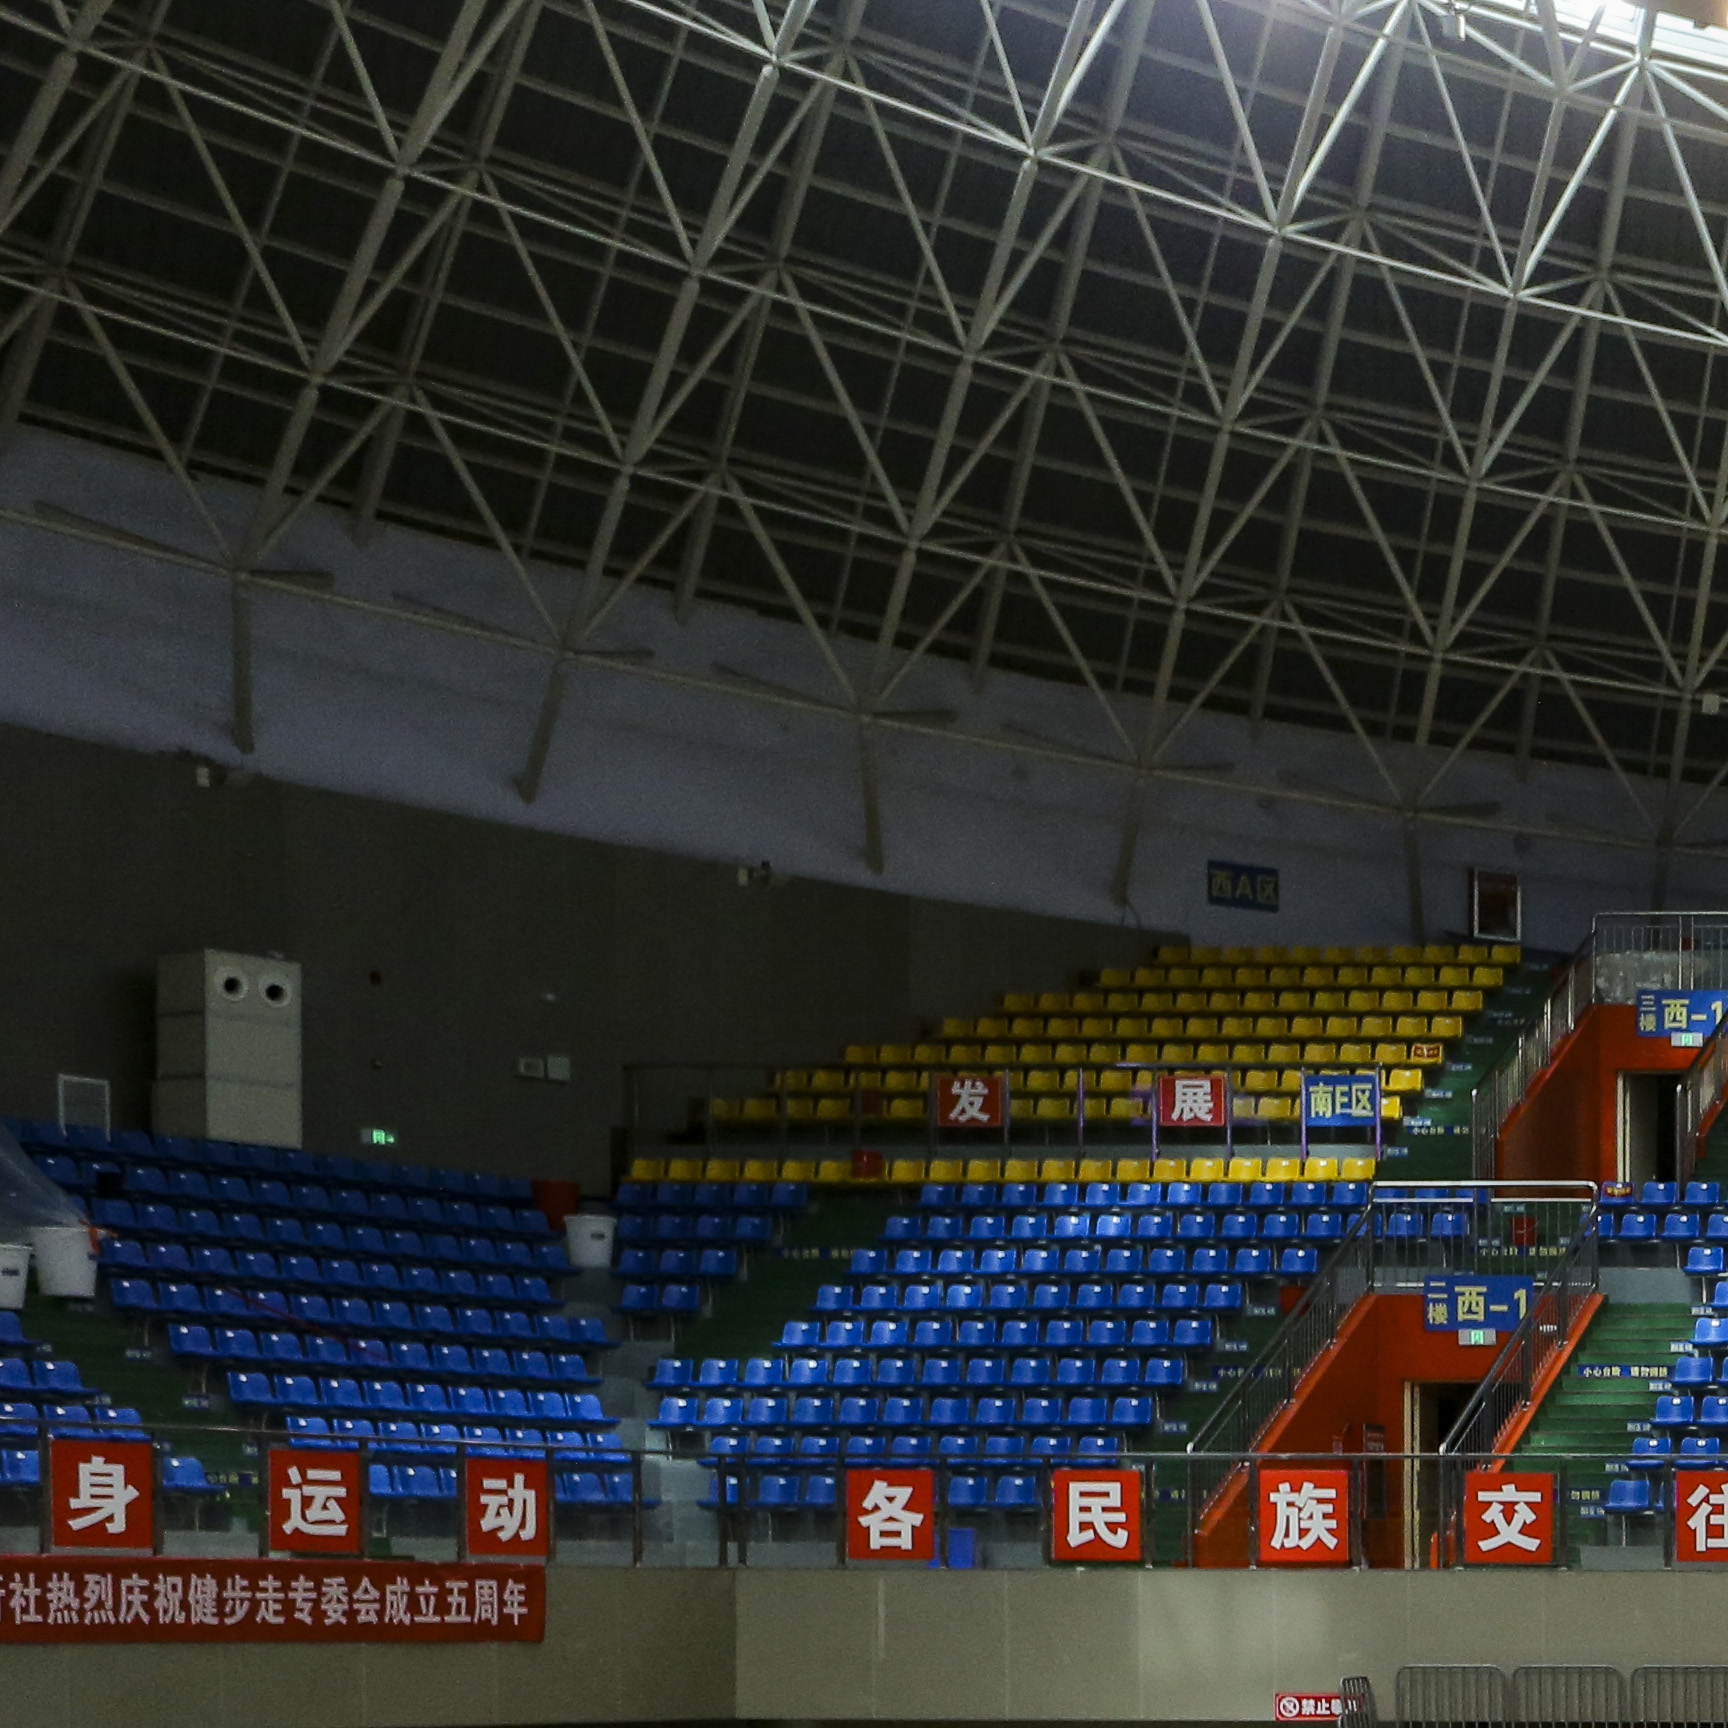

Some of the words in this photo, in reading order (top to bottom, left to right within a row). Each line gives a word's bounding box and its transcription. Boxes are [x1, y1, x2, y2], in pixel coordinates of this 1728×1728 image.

[950, 1080, 989, 1123] 发
[1171, 1079, 1214, 1122] 展
[1309, 1081, 1374, 1119] 南E区
[1427, 1281, 1449, 1325] 二楼
[1454, 1285, 1528, 1322] 西-1
[68, 1455, 139, 1534] 身
[281, 1466, 348, 1536] 运
[480, 1473, 537, 1541] 动
[858, 1481, 923, 1549] 各
[1067, 1482, 1128, 1548] 民
[1270, 1482, 1337, 1549] 族
[1478, 1484, 1541, 1551] 交
[0, 1572, 528, 1626] 社热烈庆祝健步走专委会成立五周年
